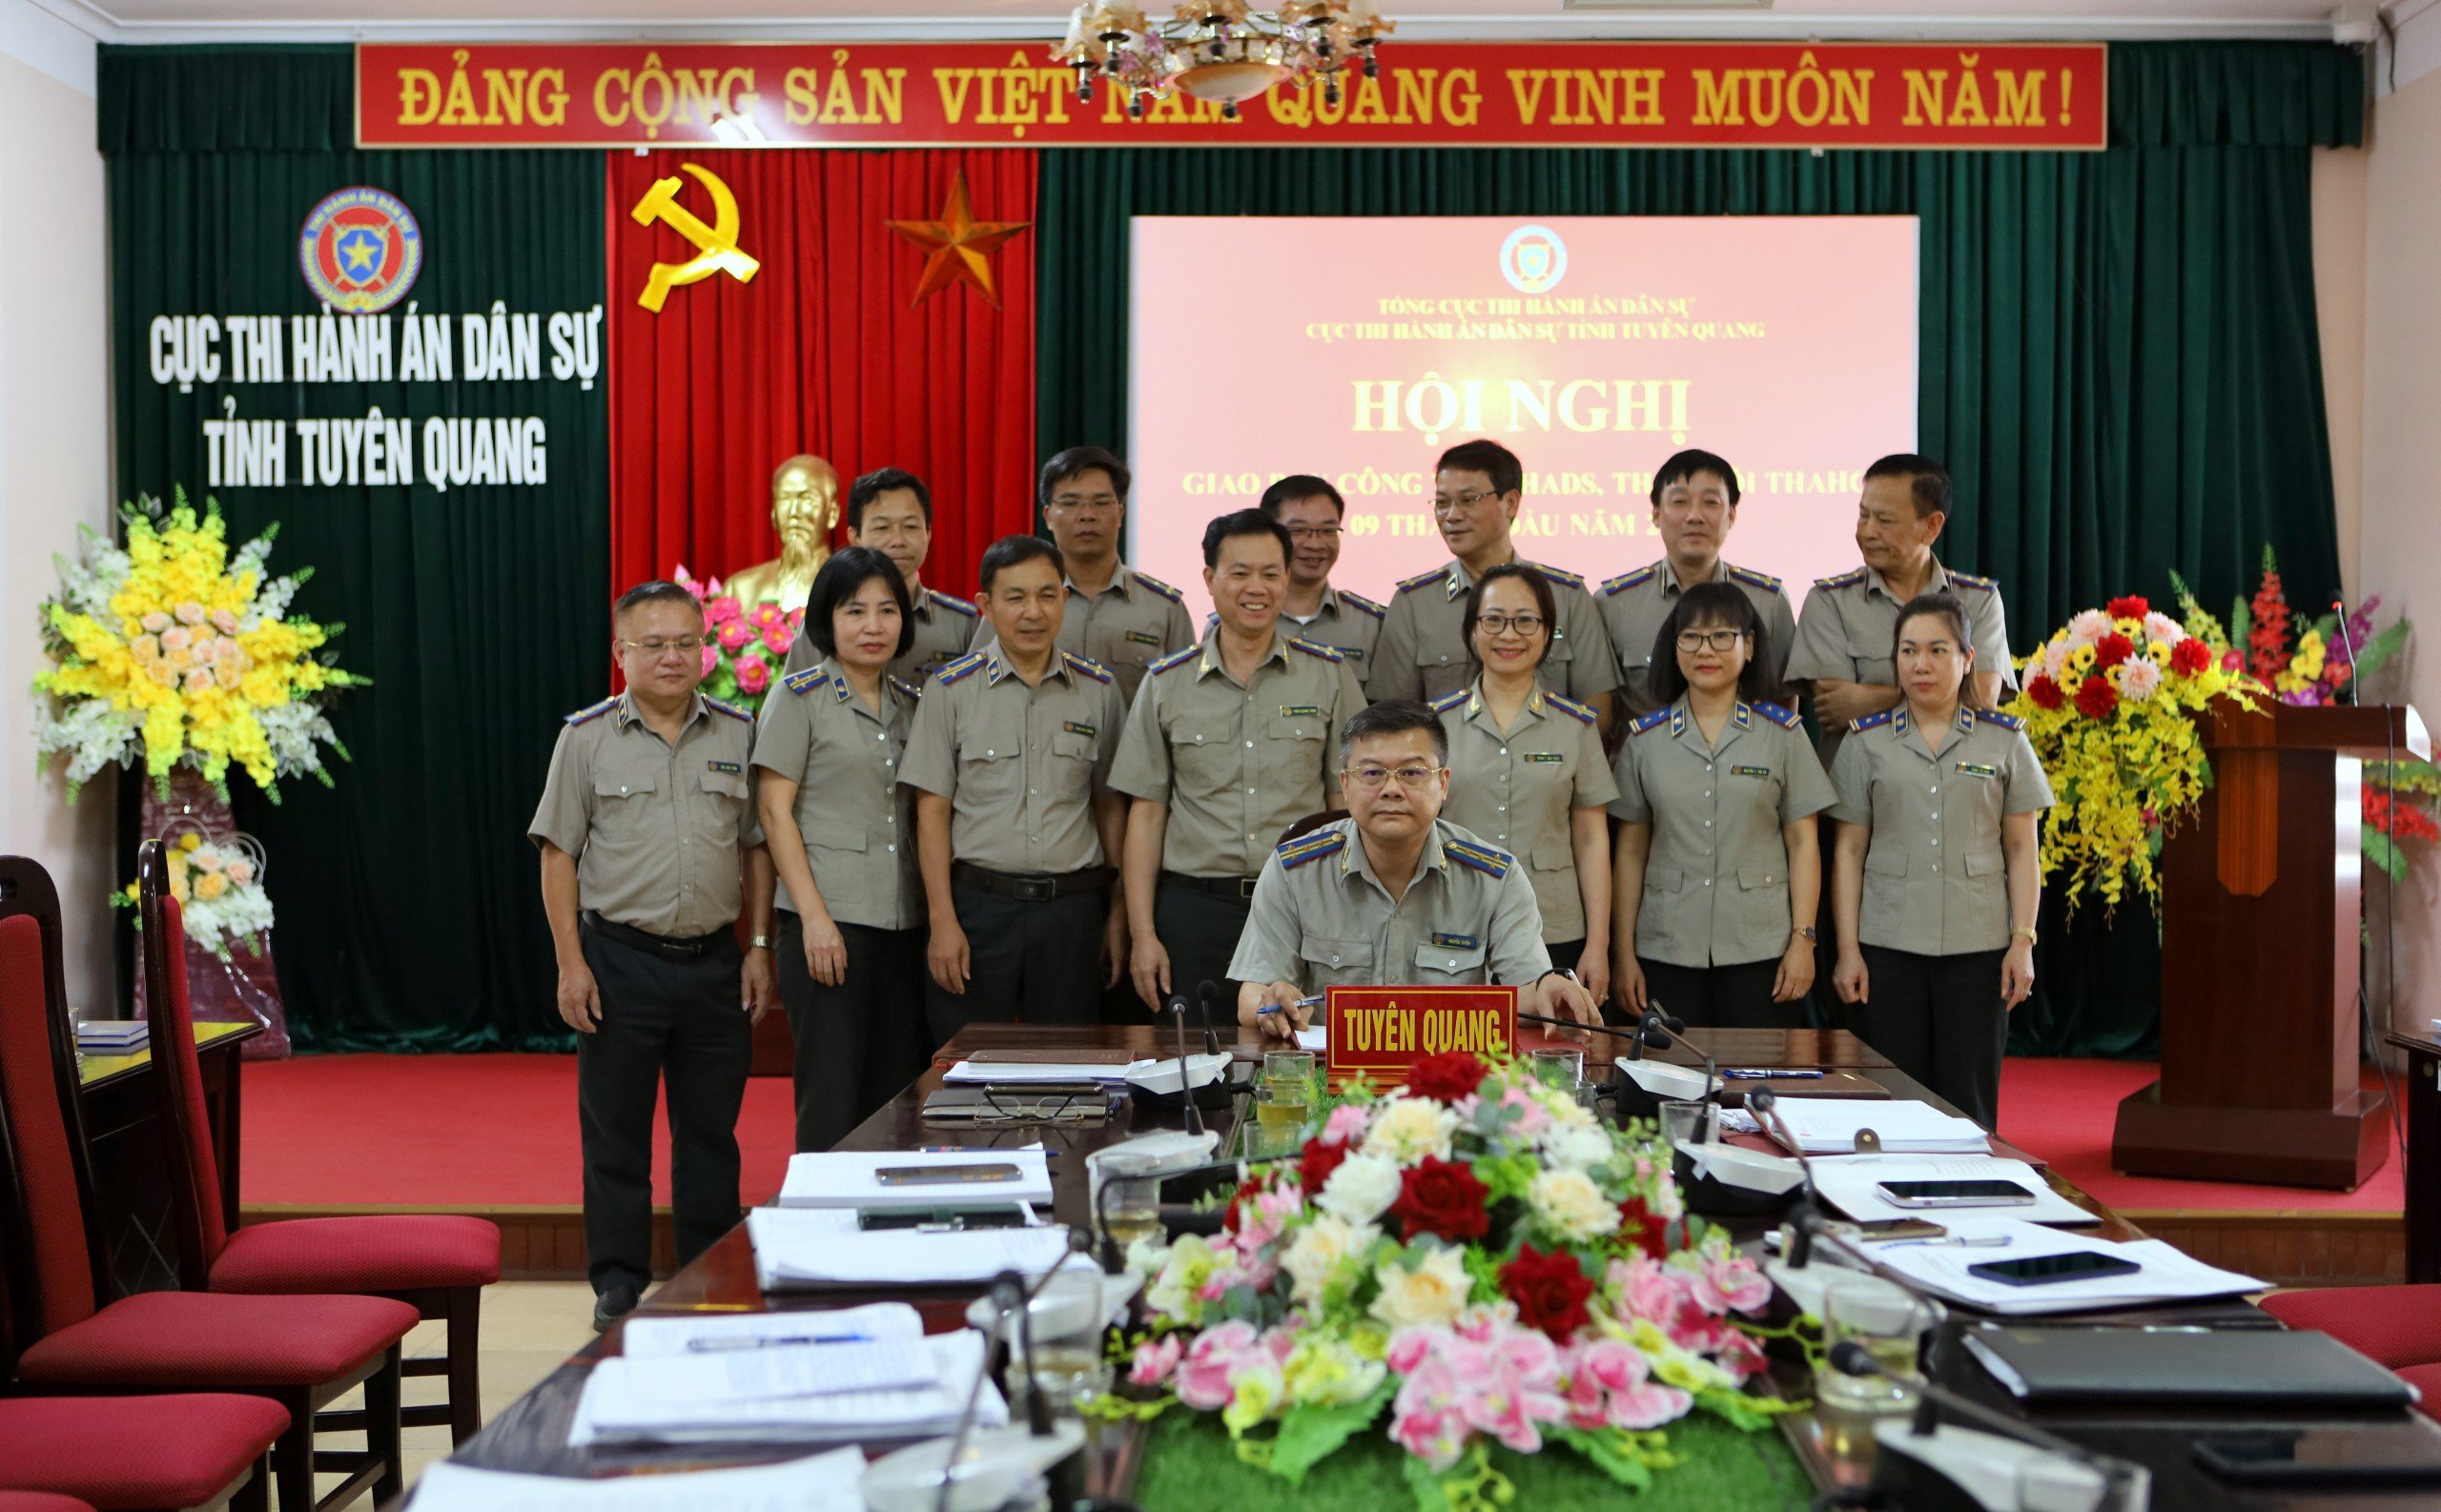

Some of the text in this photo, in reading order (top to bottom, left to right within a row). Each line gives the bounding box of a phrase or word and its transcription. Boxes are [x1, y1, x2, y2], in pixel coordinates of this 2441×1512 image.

[398, 49, 570, 127] ĐẢNG
[593, 51, 760, 139] CỘNG
[784, 49, 907, 126] SẢN
[933, 51, 1077, 138] VIỆT
[1267, 68, 1483, 130] QUANG
[1507, 69, 1665, 126] VINH
[1692, 51, 1874, 127] MUÔN
[1305, 321, 1351, 344] CỤC
[1354, 321, 1389, 339] THI
[1692, 321, 1766, 342] QUANG
[1438, 296, 1485, 320] CỤC
[1487, 297, 1521, 316] THI
[150, 300, 604, 394] CỤC THI HÀNH ÁN DÂN SỰ
[1350, 371, 1692, 446] HỘI NGHỊ
[203, 395, 547, 492] TỈNH TUYÊN QUANG
[1181, 472, 1262, 496] GIAO
[1336, 465, 1424, 496] CÔNG
[1522, 471, 1604, 498] HADS,
[1611, 471, 1653, 495] TH
[1349, 514, 1381, 538] 09
[1569, 508, 1636, 537] NĂM
[1344, 1001, 1501, 1056] TUYÊN QUANG
